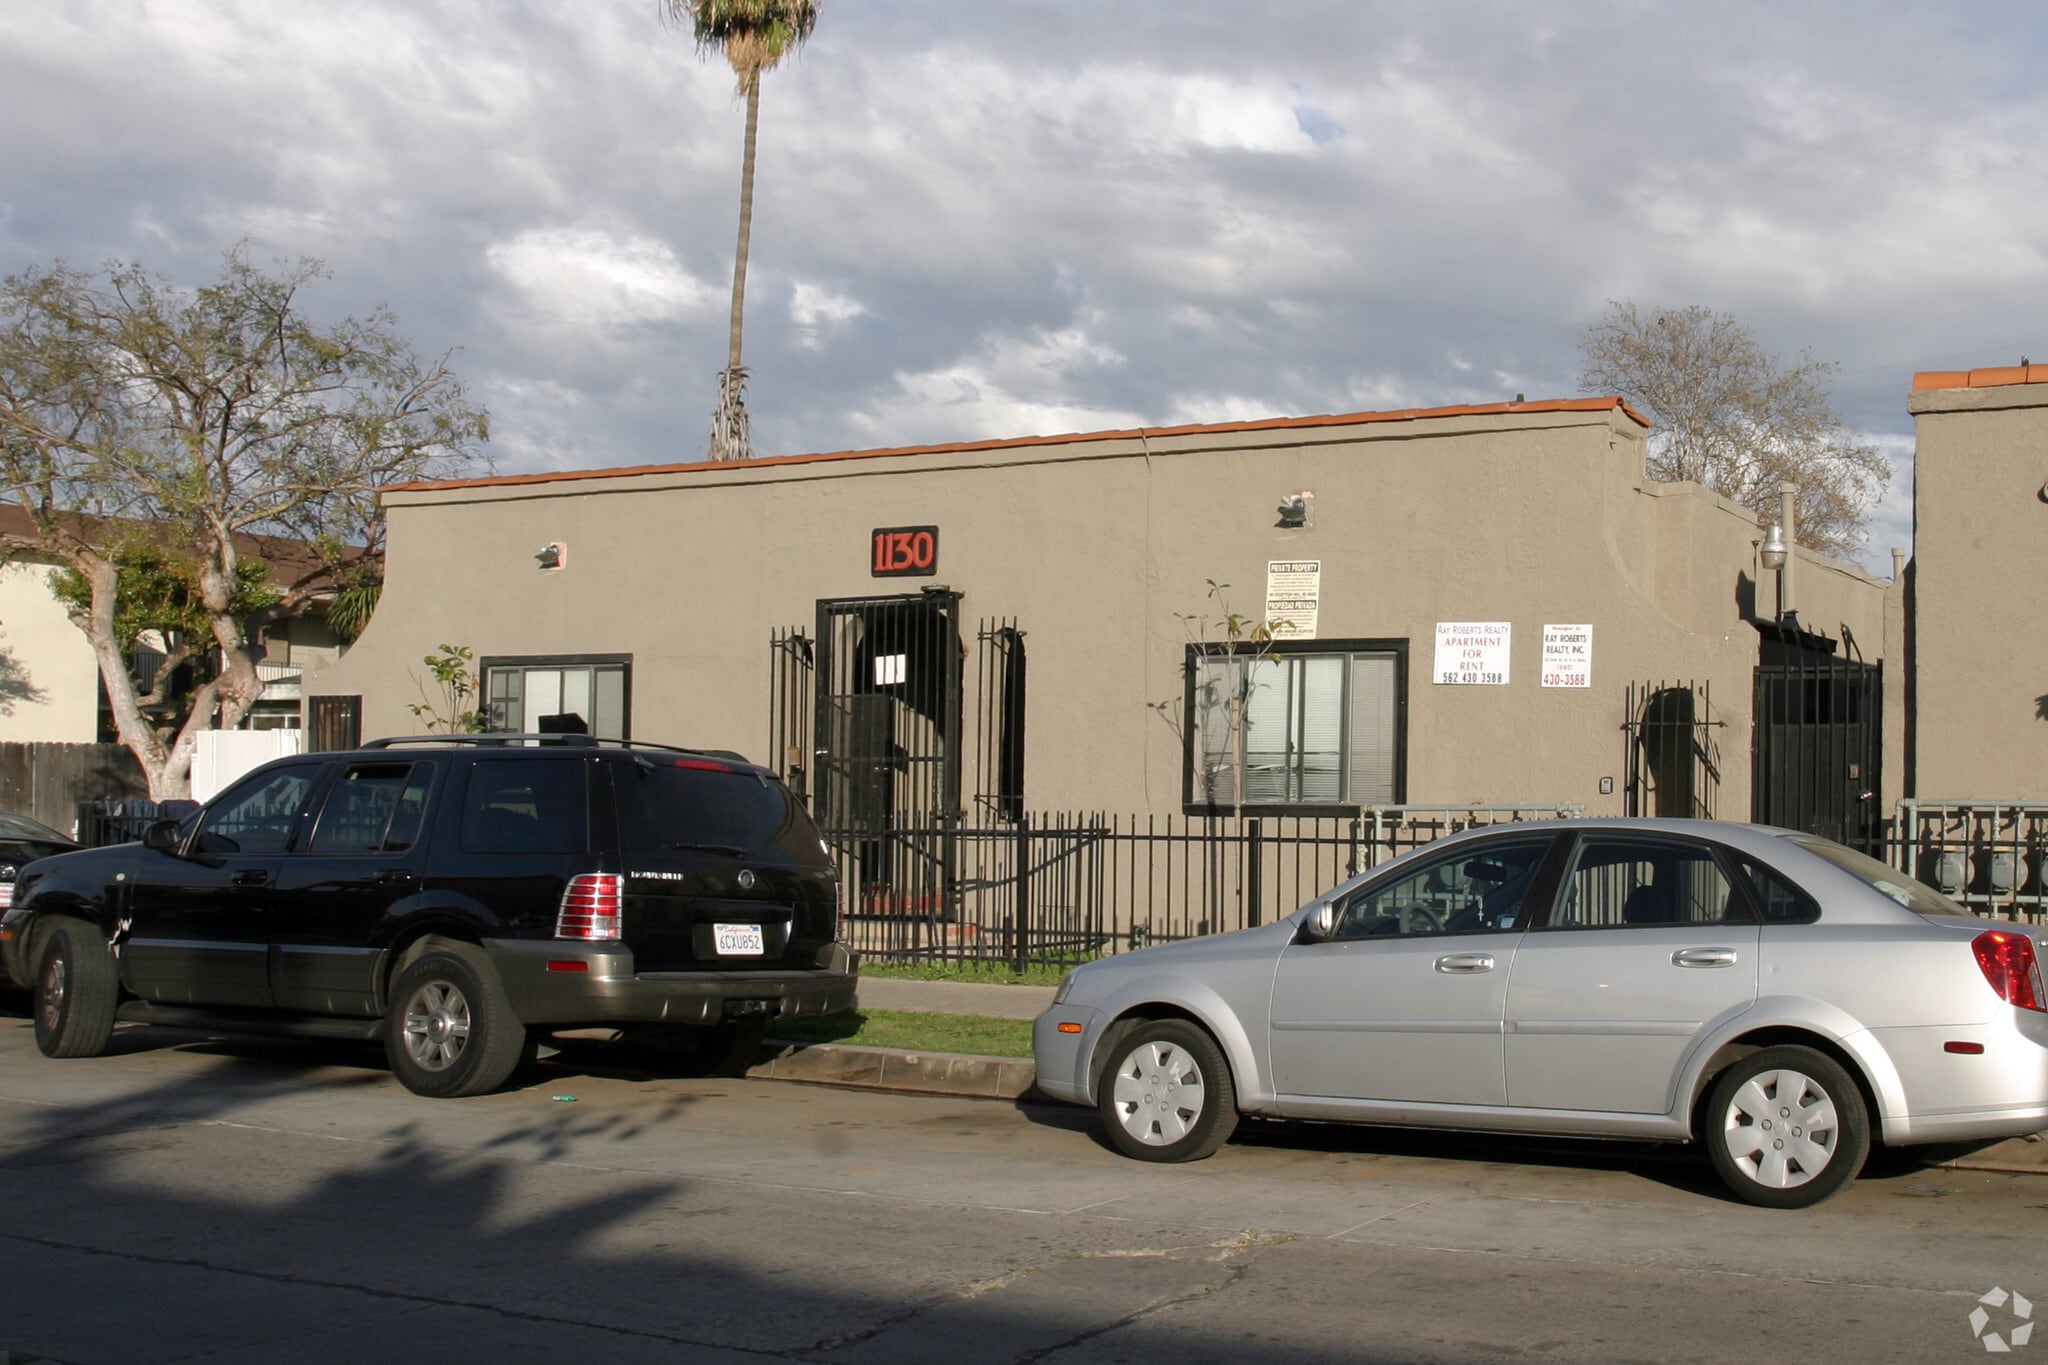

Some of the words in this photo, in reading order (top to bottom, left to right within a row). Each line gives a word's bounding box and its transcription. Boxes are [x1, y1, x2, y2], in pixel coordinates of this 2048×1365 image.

[874, 531, 933, 572] 1130
[1438, 625, 1450, 634] RAY
[1453, 625, 1482, 635] ROBERTS
[1484, 625, 1508, 635] REALTY
[1444, 637, 1501, 647] APARTMENT
[1545, 634, 1558, 643] RAY
[1560, 634, 1587, 643] ROBERTS
[1462, 649, 1482, 659] FOR
[1460, 662, 1484, 671] RENT
[1443, 672, 1458, 683] 562
[1462, 672, 1477, 683] 430
[1481, 673, 1502, 684] 3588
[1543, 673, 1586, 686] 430-3588
